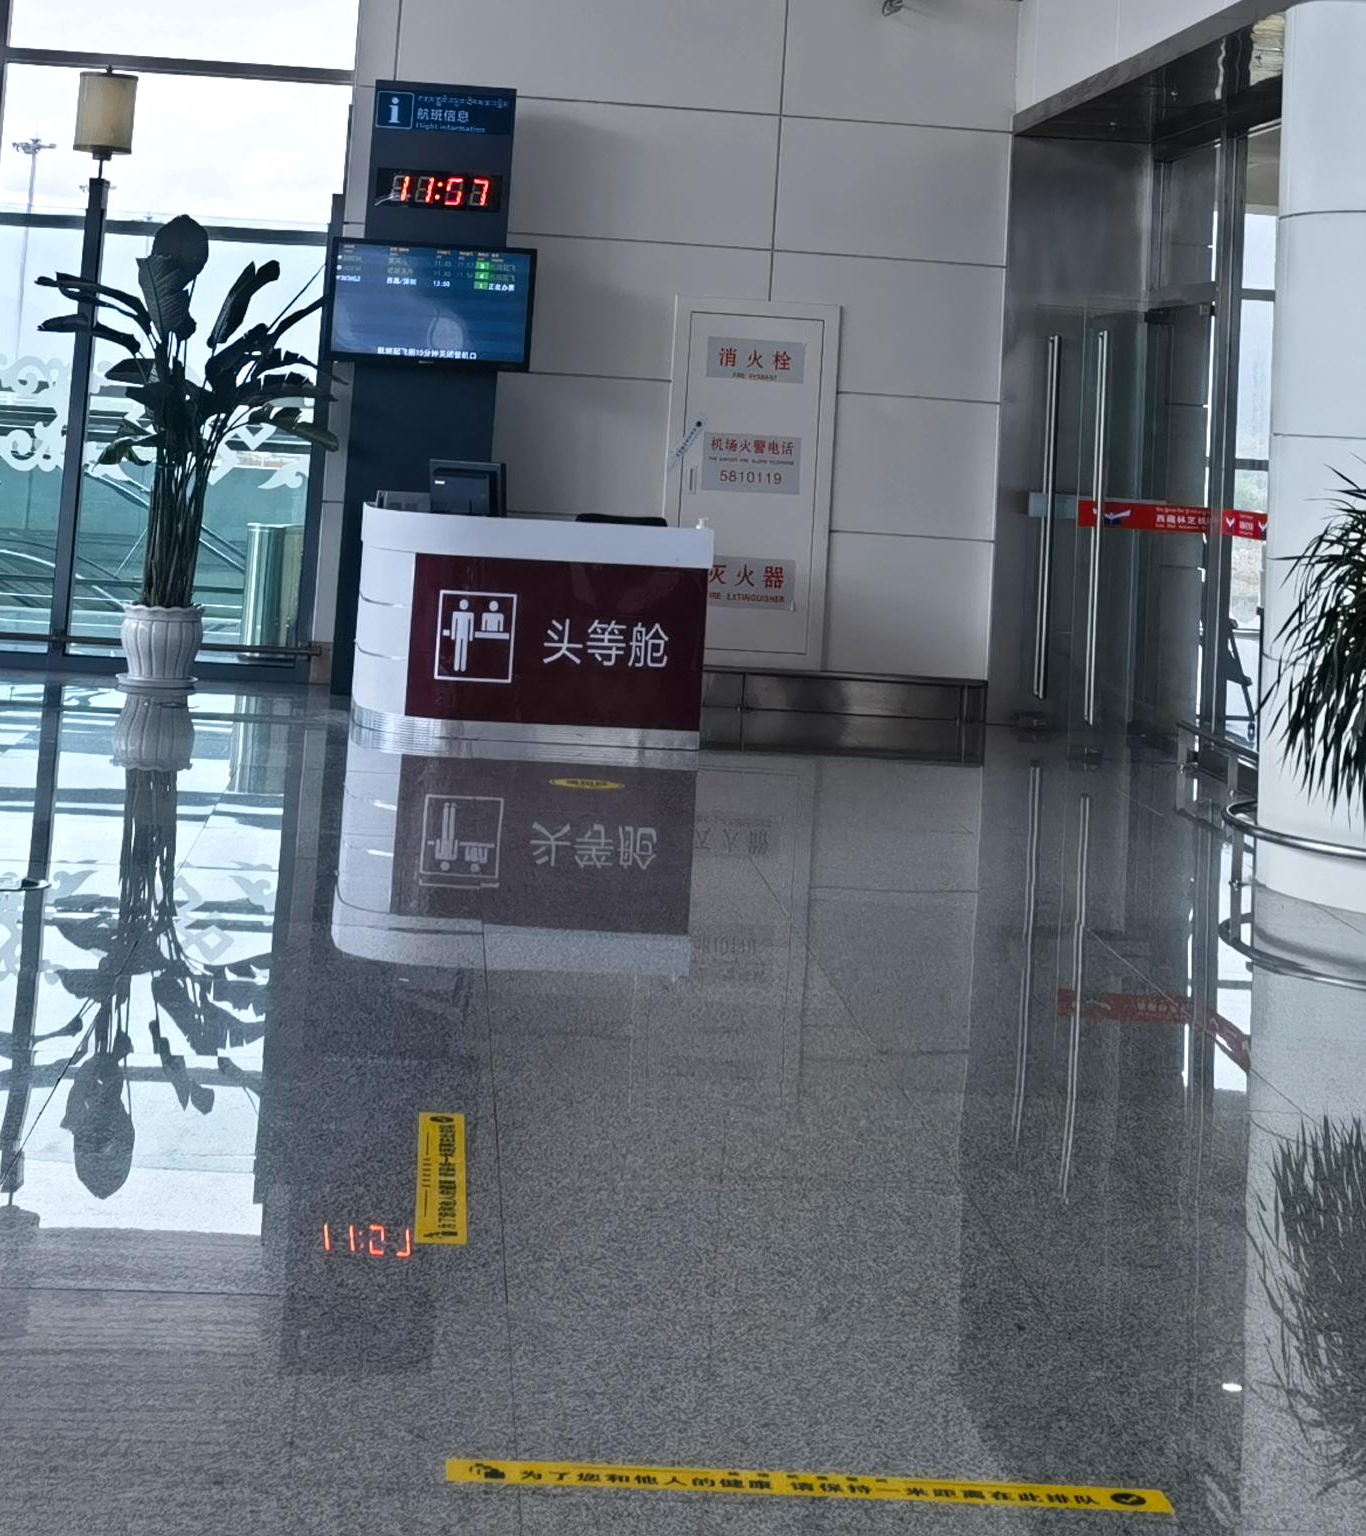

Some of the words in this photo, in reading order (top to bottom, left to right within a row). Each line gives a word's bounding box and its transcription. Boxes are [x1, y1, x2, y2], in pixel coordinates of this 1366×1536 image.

[416, 107, 470, 123] 航班信息
[399, 175, 491, 207] 11:57
[719, 347, 792, 371] 消火栓
[711, 436, 794, 457] 机场火警电话
[720, 469, 782, 485] 5810119
[709, 563, 785, 589] 灭火器
[543, 618, 669, 668] 头等舱
